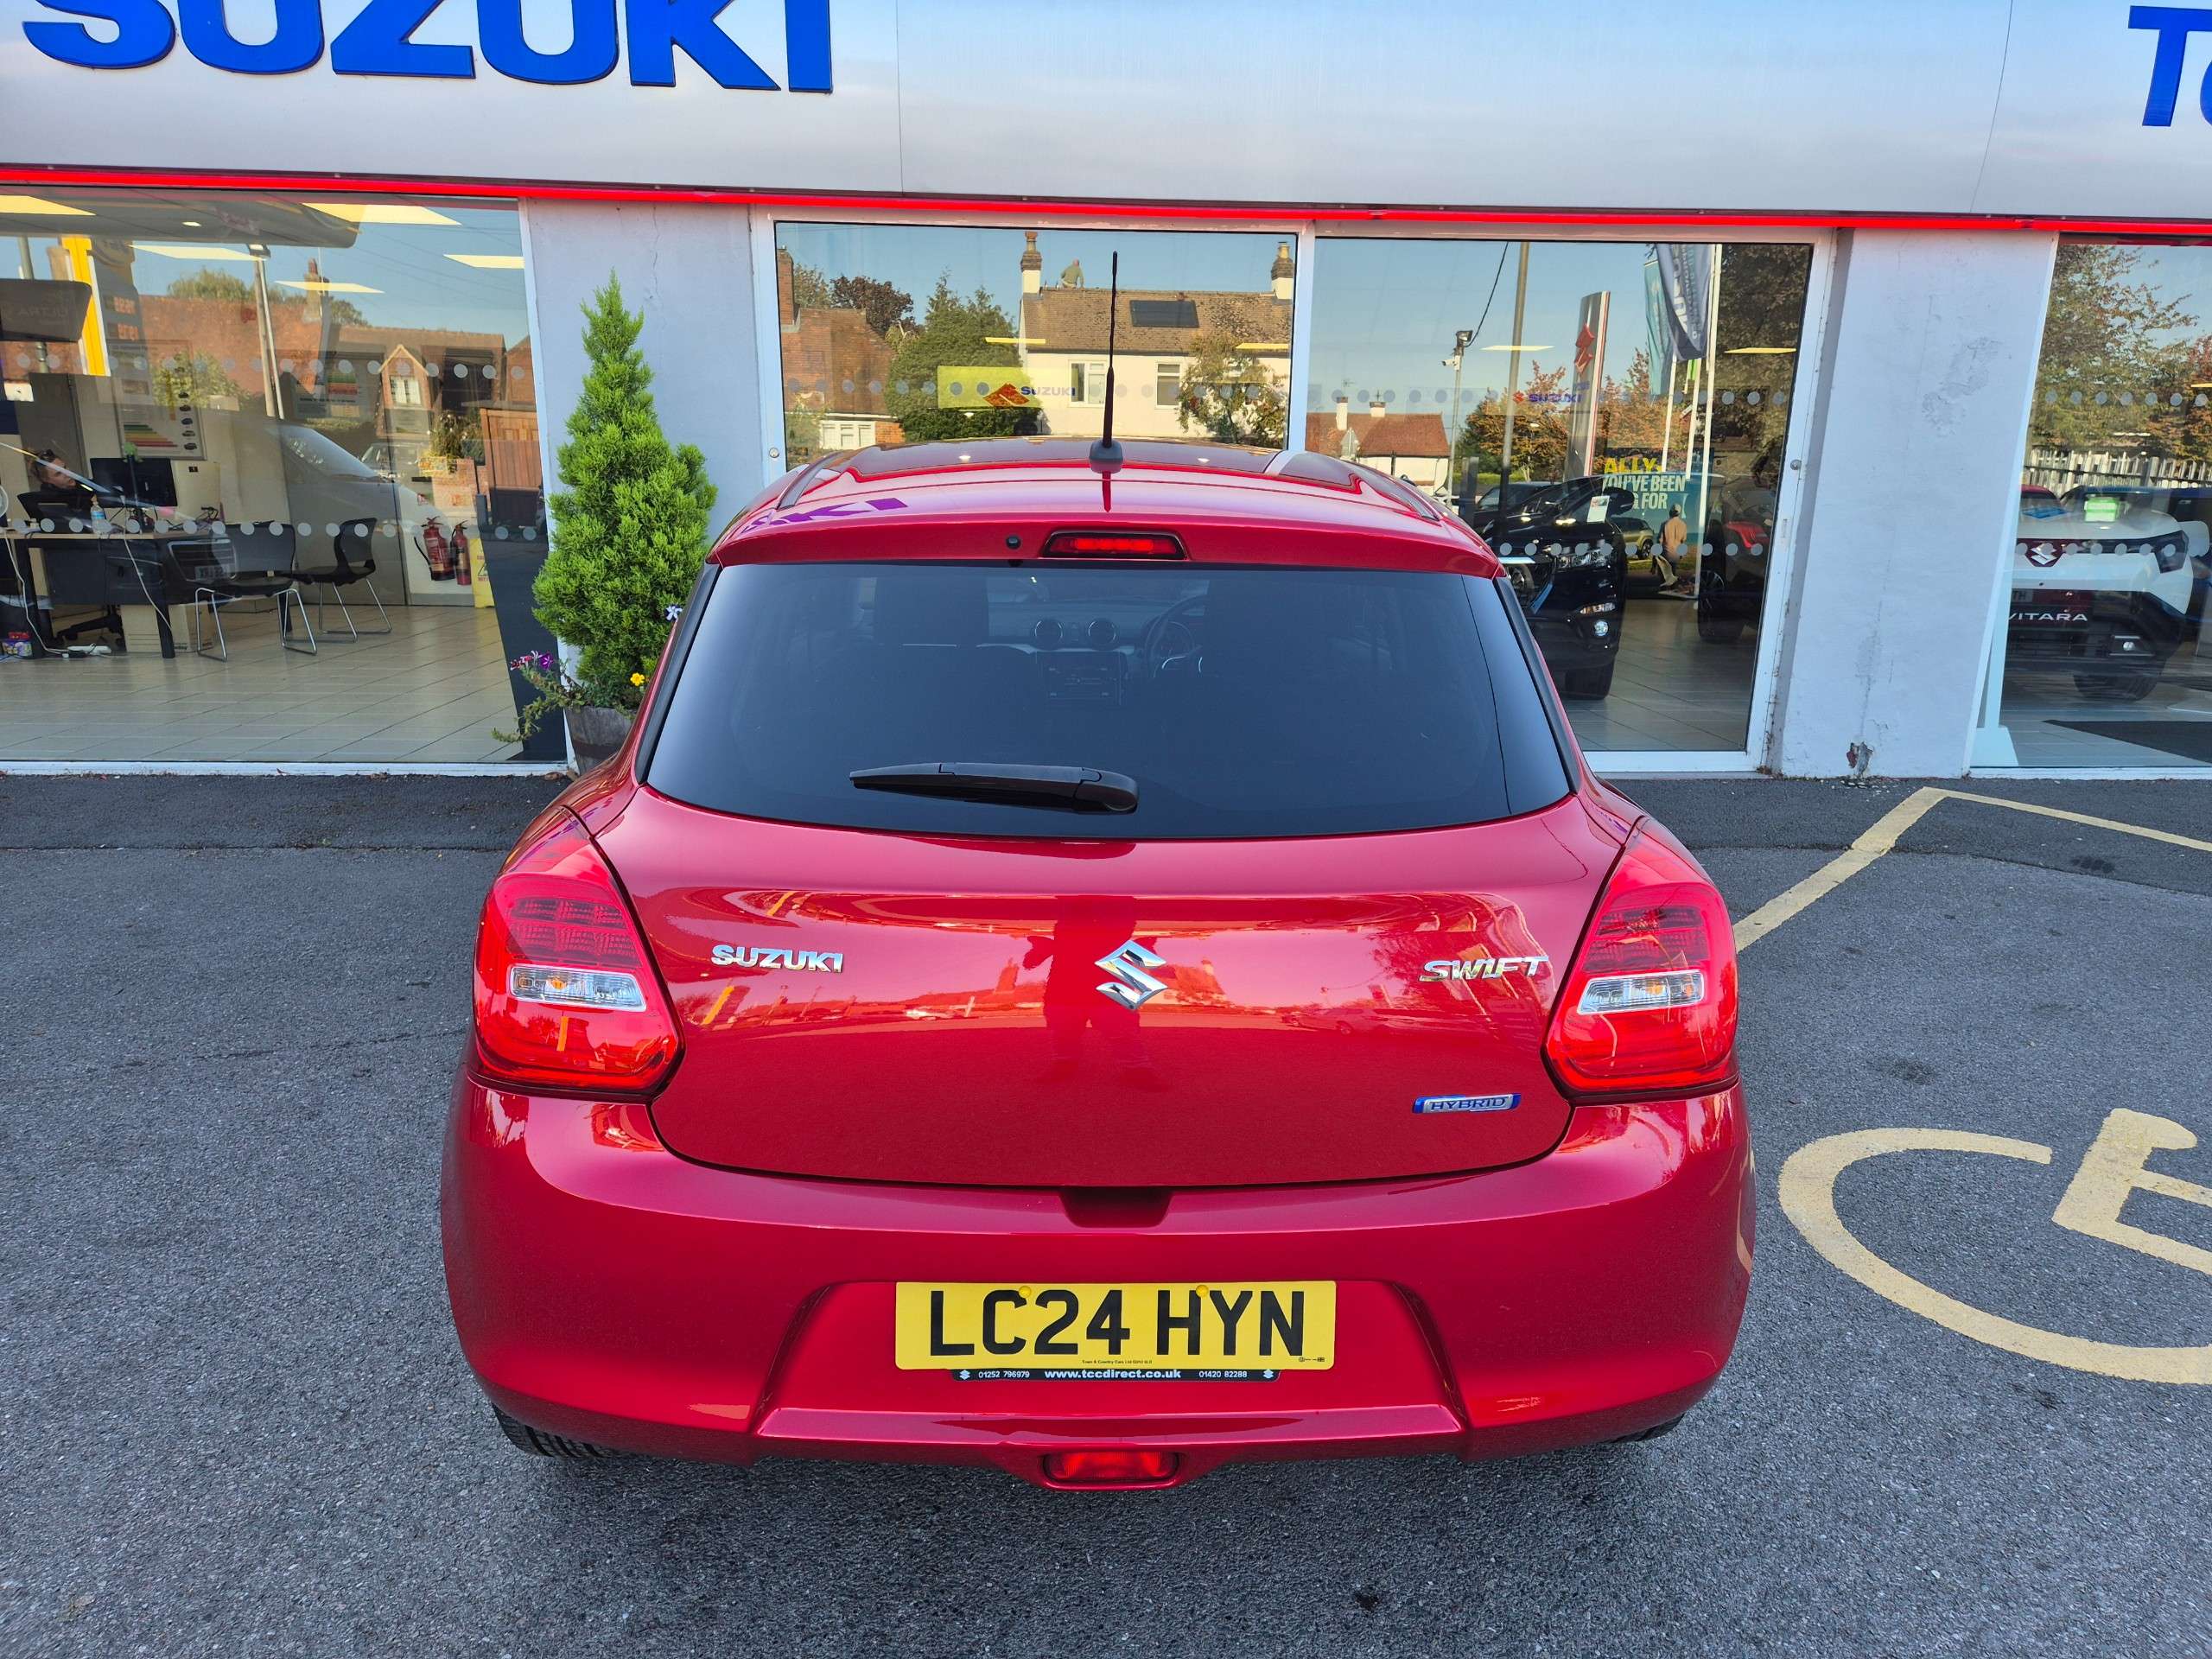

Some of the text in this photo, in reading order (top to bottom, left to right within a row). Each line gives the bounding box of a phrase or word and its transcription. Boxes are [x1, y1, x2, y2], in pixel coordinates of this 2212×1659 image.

[2127, 5, 2212, 127] T
[1020, 386, 1076, 396] SUZUKI
[1649, 474, 1687, 492] BEEN
[1641, 493, 1669, 510] FOR
[711, 944, 843, 973] SUZUKI
[1420, 956, 1549, 982] SWIFT
[1431, 1096, 1506, 1111] HYBRID
[930, 1289, 1305, 1357] LC24 HYN
[978, 1369, 1248, 1379] 01252 796979 www.tccdirect.co.uk 01420 82288
